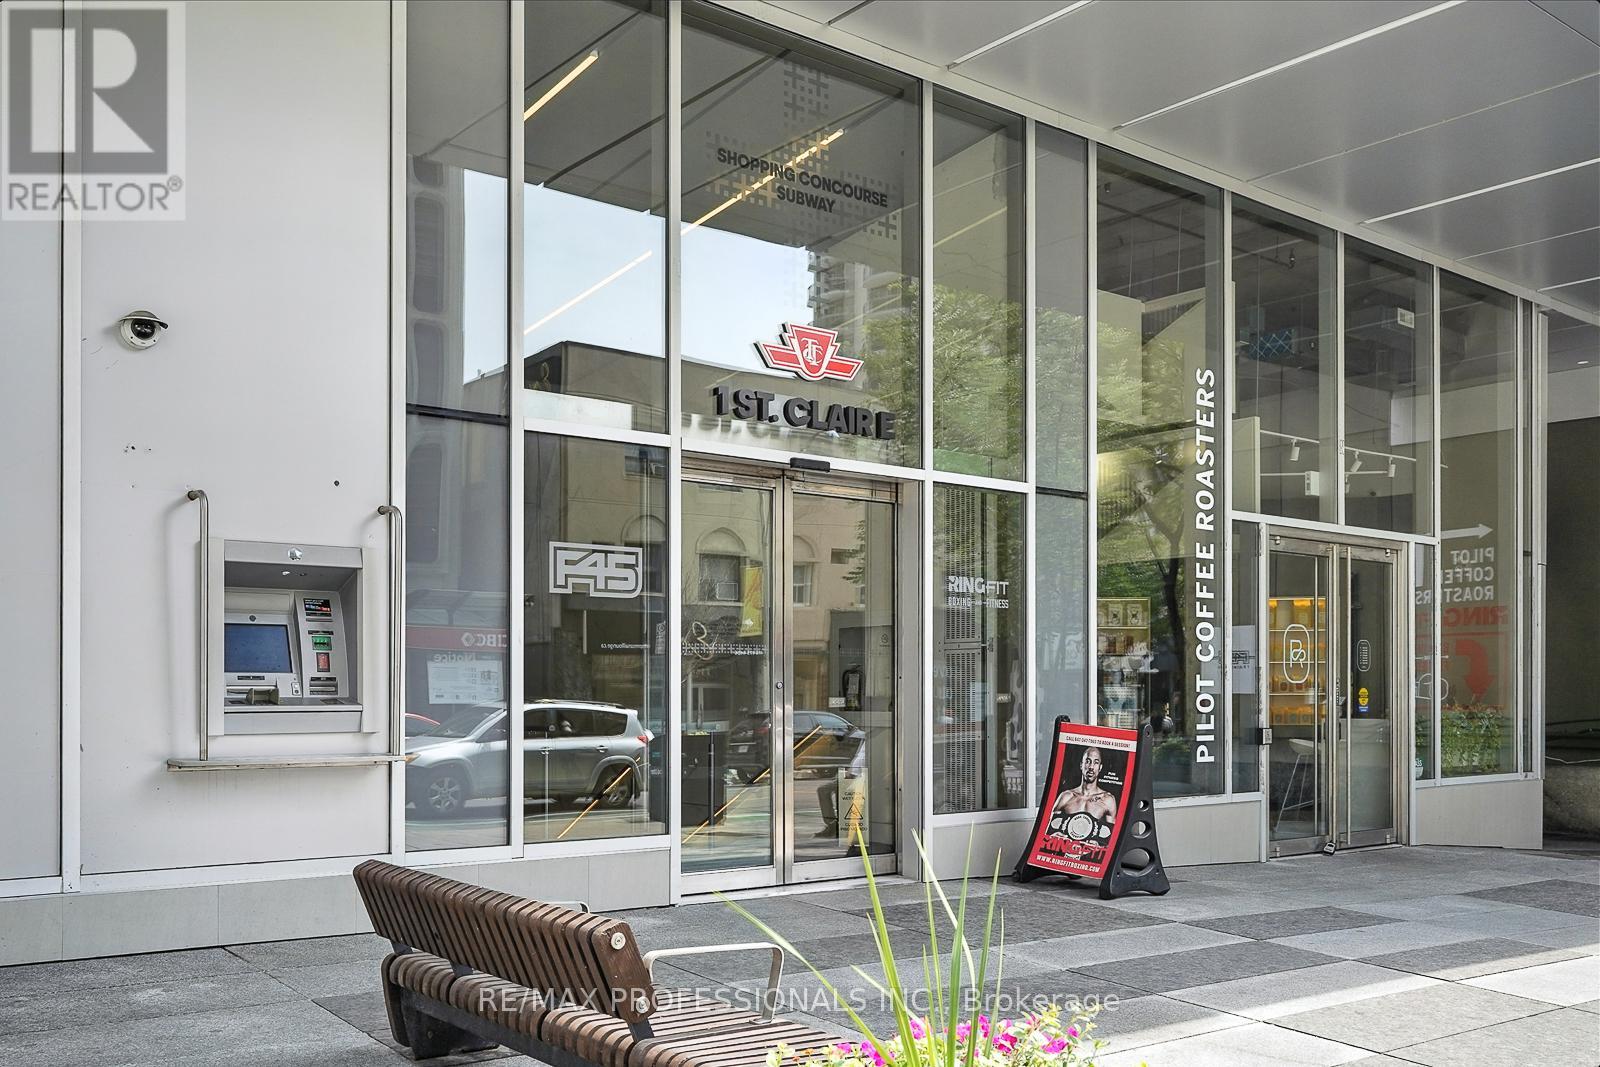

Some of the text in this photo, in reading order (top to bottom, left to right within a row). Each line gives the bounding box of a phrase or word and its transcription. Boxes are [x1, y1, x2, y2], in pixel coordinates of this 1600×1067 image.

[717, 147, 888, 208] SHOPPING CONCOURSE
[776, 185, 836, 213] SUBWAY
[552, 545, 641, 594] F45
[1195, 367, 1215, 763] PILOT COFFEE ROASTERS
[986, 598, 1009, 608] FITNESS
